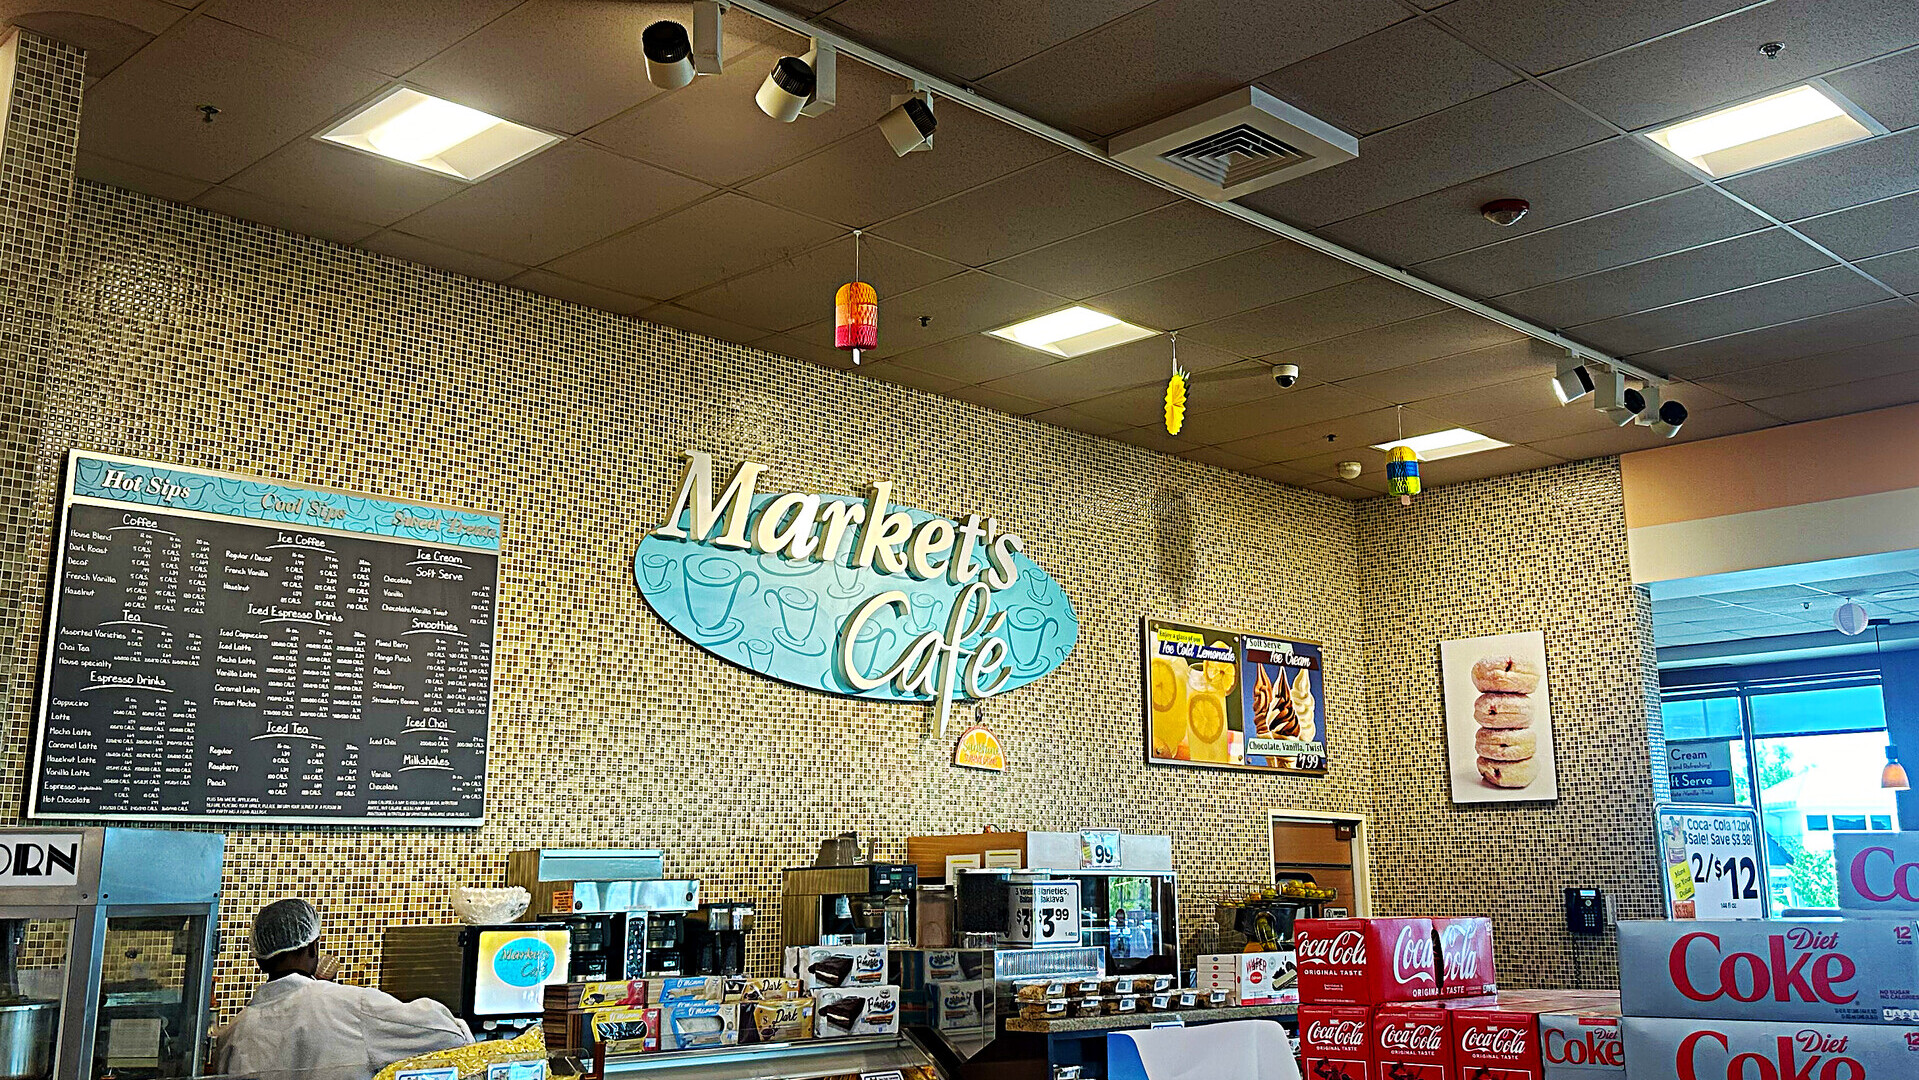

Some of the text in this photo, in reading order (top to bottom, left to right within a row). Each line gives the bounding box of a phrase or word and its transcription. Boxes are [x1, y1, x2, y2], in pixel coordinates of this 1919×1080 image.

[102, 470, 191, 503] Hot Sips
[261, 493, 347, 524] Cool Sips
[123, 514, 158, 528] Coffee
[656, 449, 1024, 590] Market's
[70, 530, 112, 541] House Blend
[277, 532, 326, 548] Ice Coffee
[69, 544, 108, 554] Dark Roast
[226, 551, 249, 560] Regular
[416, 549, 463, 563] Ice Cream
[68, 557, 89, 567] Decaf
[225, 566, 269, 577] French Vanilla
[416, 567, 463, 581] Soft Serve
[66, 572, 117, 584] French Vanilla
[384, 575, 413, 585] Chocolate
[384, 589, 404, 598] Vanilla
[123, 610, 141, 622] Tea
[247, 604, 344, 622] Iced Espresso Drinks
[412, 618, 458, 631] Smoothies
[61, 627, 127, 640] Assorted Varieties
[220, 629, 233, 637] Iced
[59, 643, 90, 652] Chai Tea
[219, 642, 252, 652] Iced Latte
[393, 641, 409, 650] Berry
[1264, 641, 1281, 649] Serve
[1162, 640, 1236, 662] Ice Cold Lemonade
[59, 658, 112, 669] House specialty
[217, 656, 256, 665] Mocha Latte
[375, 654, 395, 663] Mango
[839, 581, 1013, 740] Café
[1270, 649, 1311, 667] Ice Cream
[90, 671, 166, 686] Espresso Drinks
[216, 669, 257, 679] Vanilla Latte
[215, 684, 261, 694] Caramel Latte
[373, 682, 405, 692] Strawberry
[53, 698, 89, 707] Cappuccino
[51, 713, 71, 721] Latte
[405, 716, 448, 729] Iced Chai
[73, 728, 92, 737] Latte
[267, 722, 309, 734] Iced Tea
[79, 742, 98, 750] Latte
[209, 746, 233, 755] Regular
[1249, 741, 1281, 751] Chocolate,
[1306, 744, 1323, 752] Twist
[77, 756, 96, 764] Latte
[1671, 749, 1707, 760] Cream
[403, 755, 450, 766] Milkshakes
[46, 768, 90, 777] Vanilla Latte
[208, 762, 239, 772] Raspberry
[1671, 774, 1713, 787] ft Serve
[44, 782, 76, 791] Espresso
[369, 783, 398, 791] Chocolate
[57, 796, 91, 804] Chocolate
[1687, 818, 1751, 833] Coca- Cola 12pk
[1688, 833, 1709, 845] Sale!
[1711, 833, 1730, 845] Save
[1786, 926, 1840, 950] Diet
[1893, 926, 1912, 939] 12
[1669, 932, 1859, 1005] Coke
[762, 979, 782, 992] Dark
[1447, 986, 1465, 995] TASTE
[772, 1009, 798, 1025] Dark
[1307, 1020, 1366, 1046] Coca-Cola
[1381, 1023, 1444, 1050] Coca-Cola
[1594, 1028, 1618, 1040] Diet
[1462, 1026, 1529, 1054] Coca-Cola
[1796, 1029, 1849, 1054] Diet
[1544, 1028, 1625, 1066] Coke
